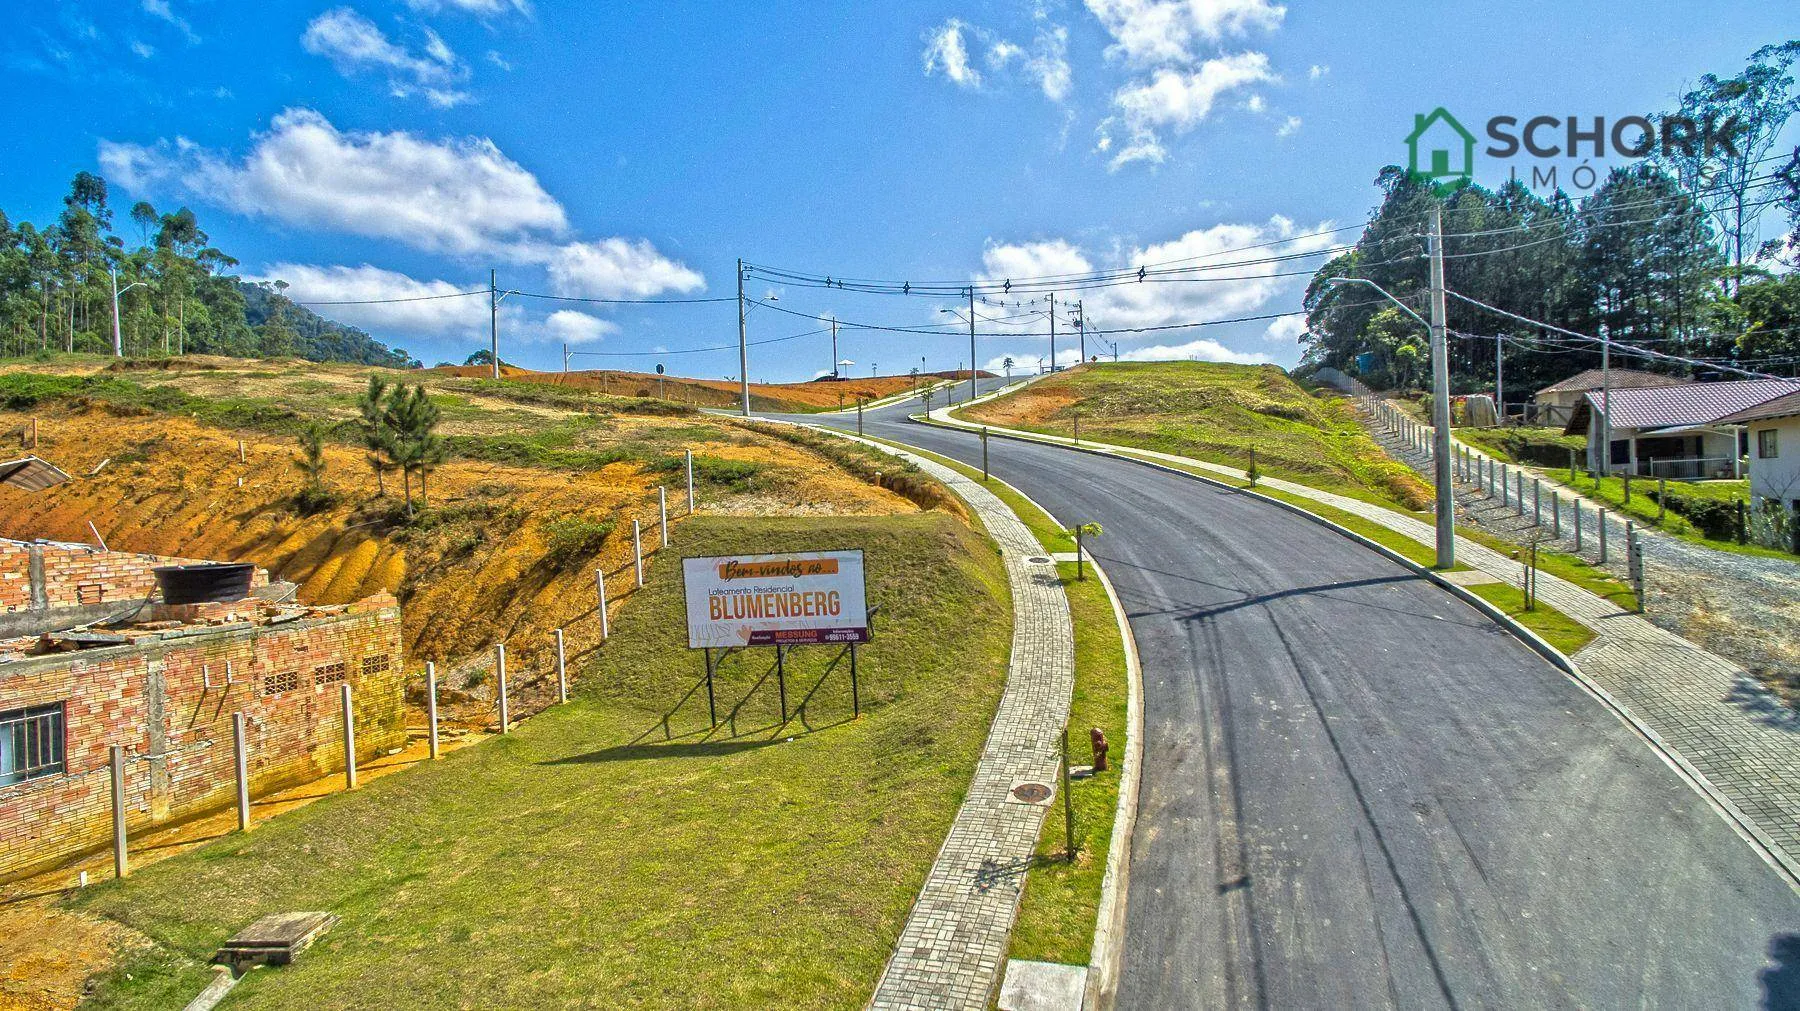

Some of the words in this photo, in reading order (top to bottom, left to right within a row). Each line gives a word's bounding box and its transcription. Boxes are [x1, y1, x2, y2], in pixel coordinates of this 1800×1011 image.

[724, 559, 803, 582] Bem-vindos
[708, 586, 752, 596] Loteamento
[753, 585, 795, 594] Residencial
[708, 590, 841, 621] BLUMENBERG
[774, 630, 818, 639] MESSUNG
